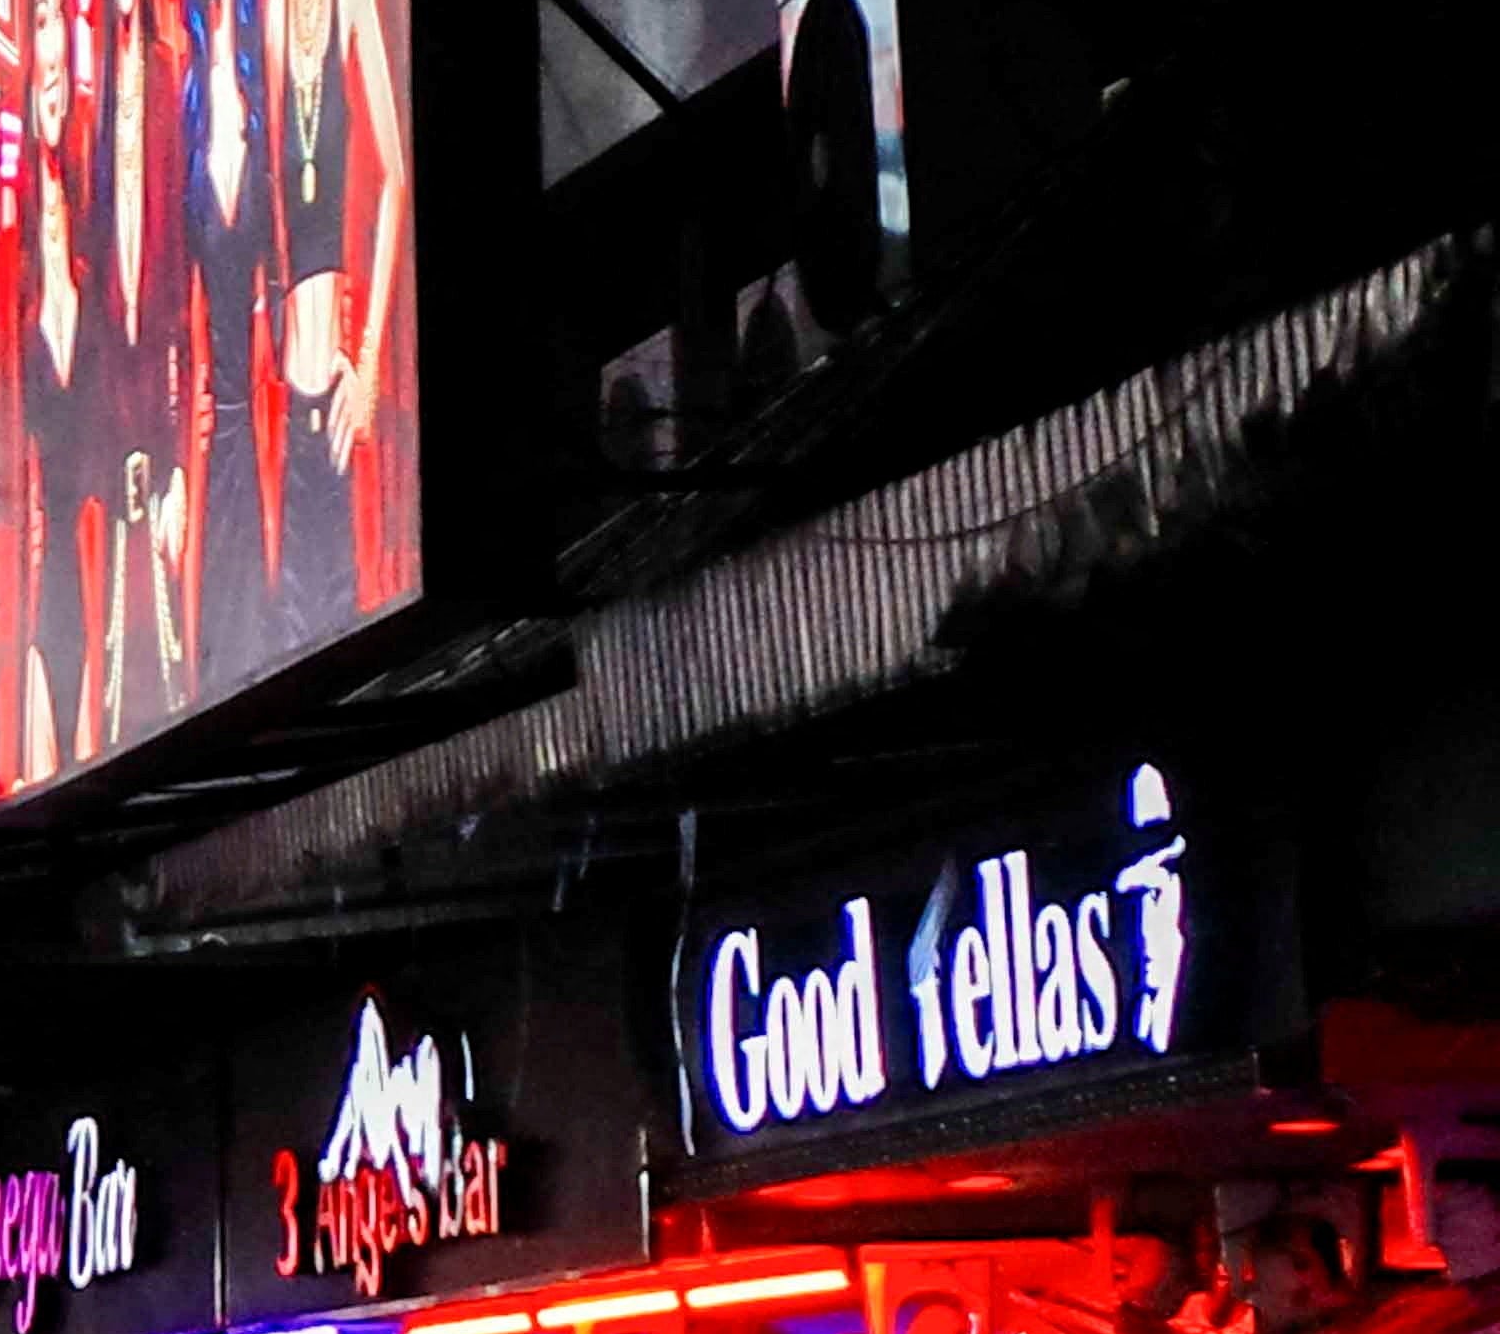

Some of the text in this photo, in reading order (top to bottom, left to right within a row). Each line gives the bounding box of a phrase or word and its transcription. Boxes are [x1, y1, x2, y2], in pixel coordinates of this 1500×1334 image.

[708, 897, 885, 1135] Good
[67, 1117, 138, 1290] Bar
[272, 1148, 299, 1278] 3
